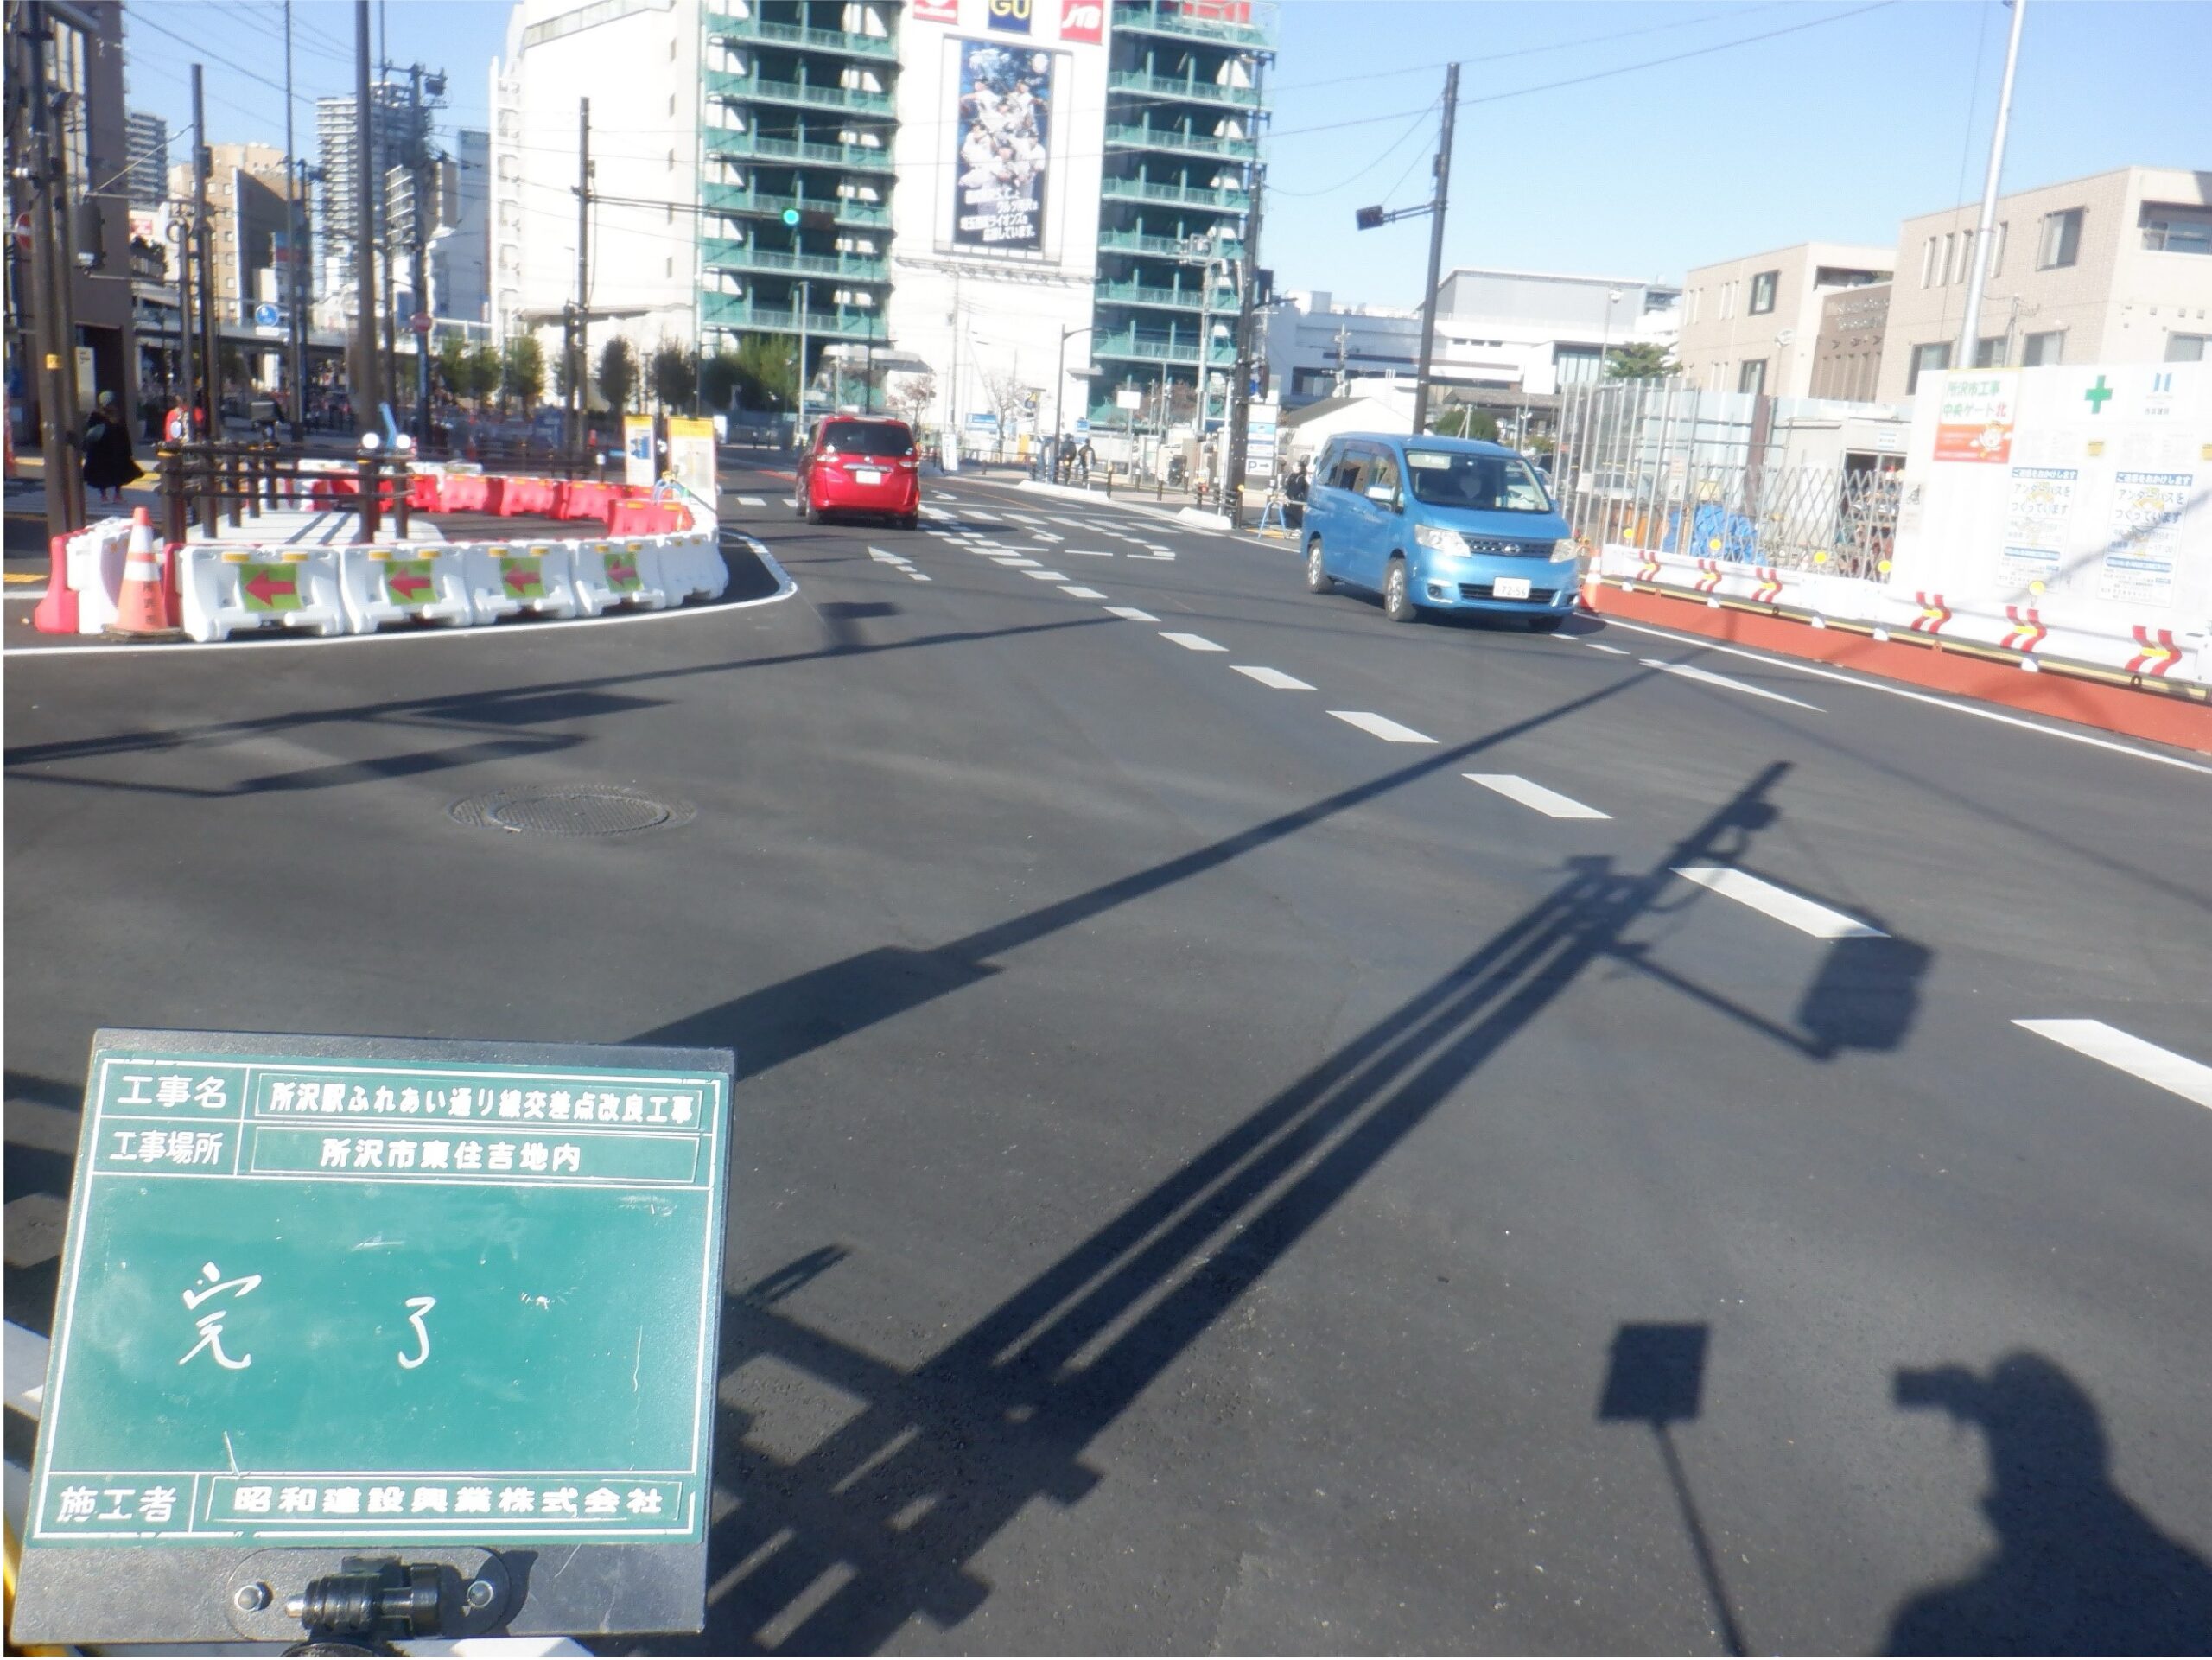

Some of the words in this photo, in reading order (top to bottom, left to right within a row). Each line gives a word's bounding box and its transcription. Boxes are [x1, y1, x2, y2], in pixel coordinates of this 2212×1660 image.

[990, 0, 1030, 19] GU
[1061, 3, 1101, 29] JTB
[1248, 461, 1257, 473] P
[118, 1075, 226, 1109] 工事名
[110, 1130, 224, 1165] 工事場所
[321, 1138, 581, 1172] 所沢市東住吉地内
[56, 1486, 177, 1523] 施工者
[232, 1485, 664, 1515] 昭和建設興業株式会社
